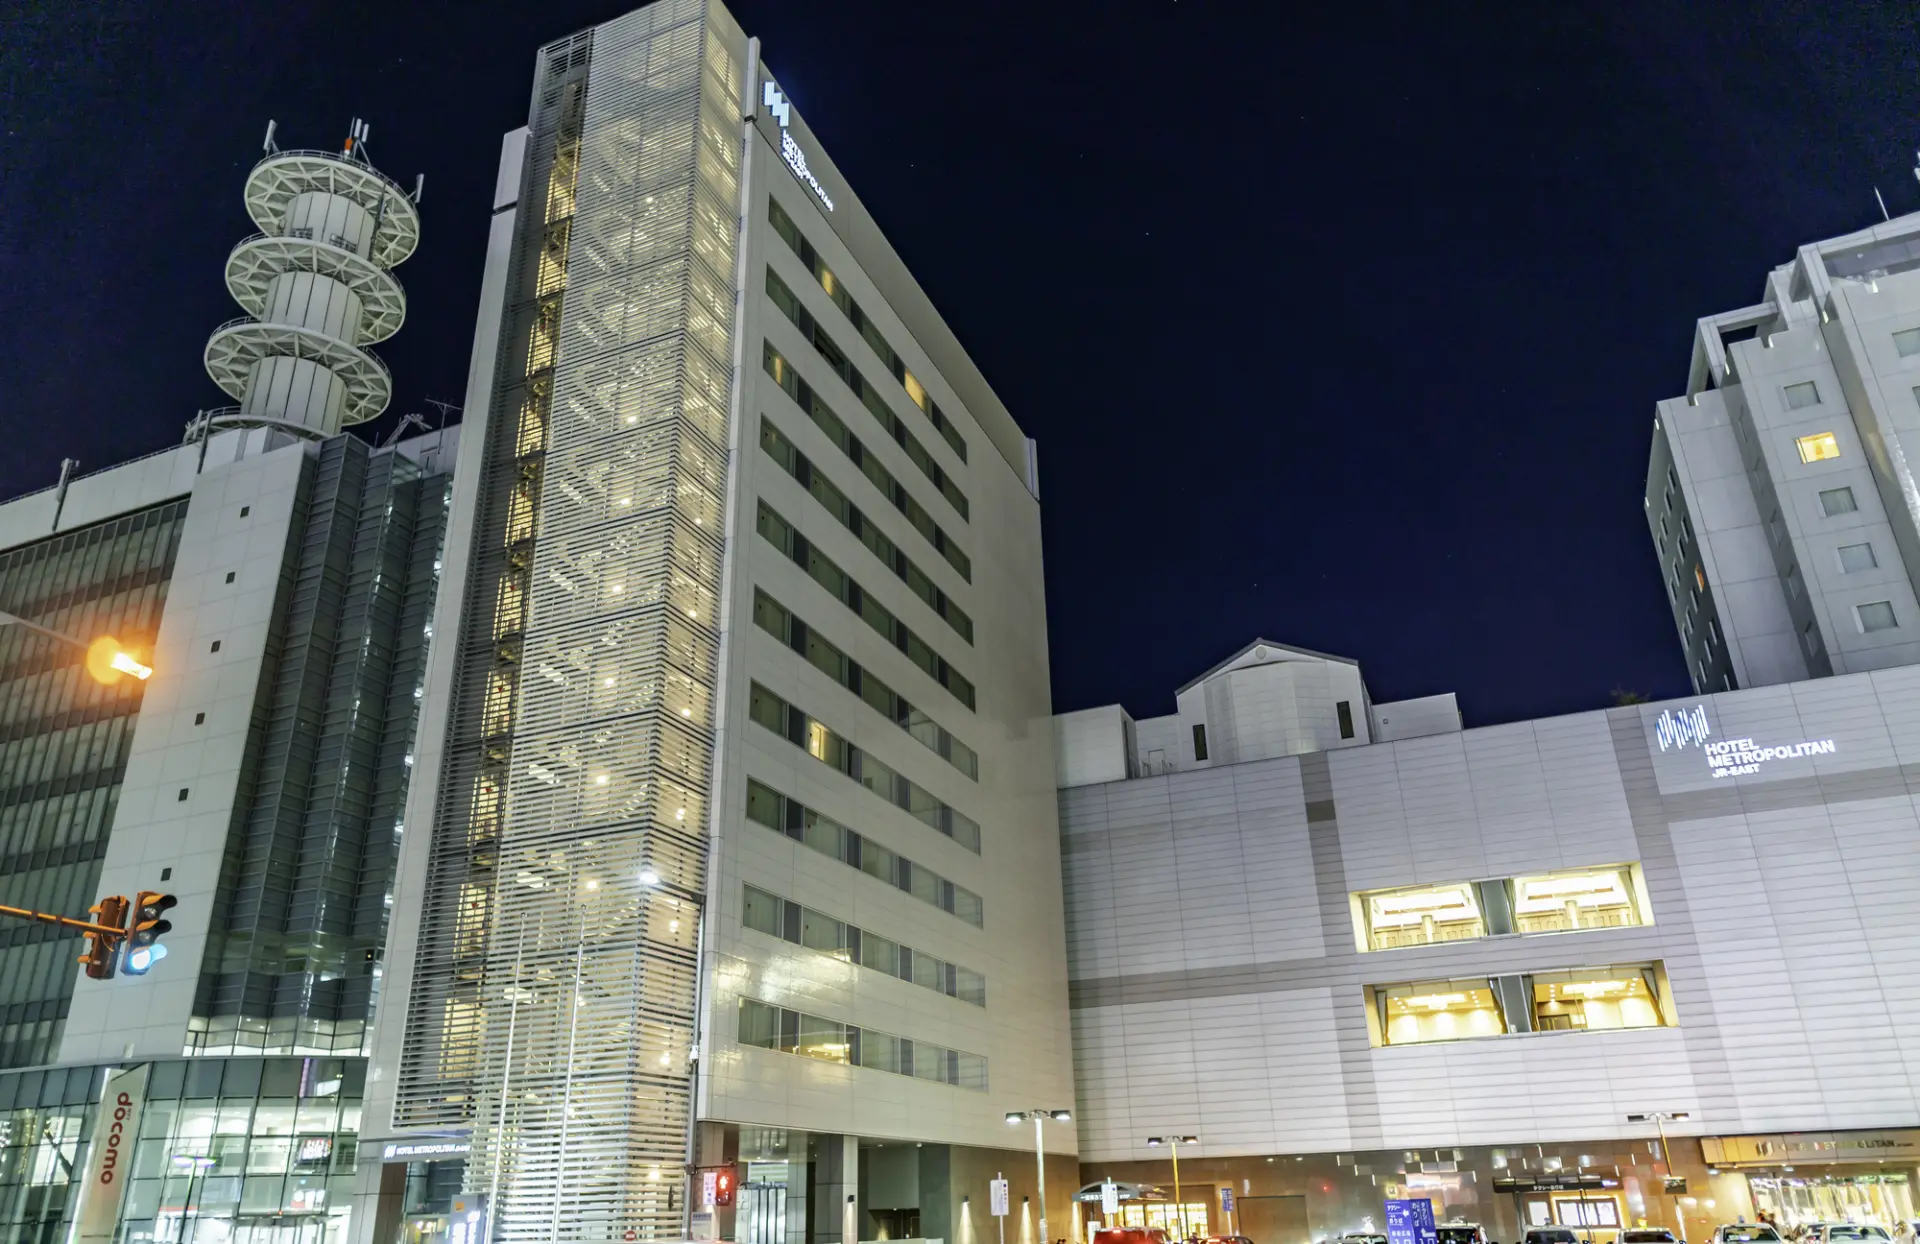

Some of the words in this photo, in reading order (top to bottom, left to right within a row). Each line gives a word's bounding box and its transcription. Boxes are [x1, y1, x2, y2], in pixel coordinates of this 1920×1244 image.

[1704, 738, 1760, 756] HOTEL
[1707, 739, 1837, 768] METROPOLITAN
[1711, 763, 1761, 778] JR-EAST
[101, 1092, 133, 1185] docomo
[1812, 1139, 1895, 1151] METOLITAN
